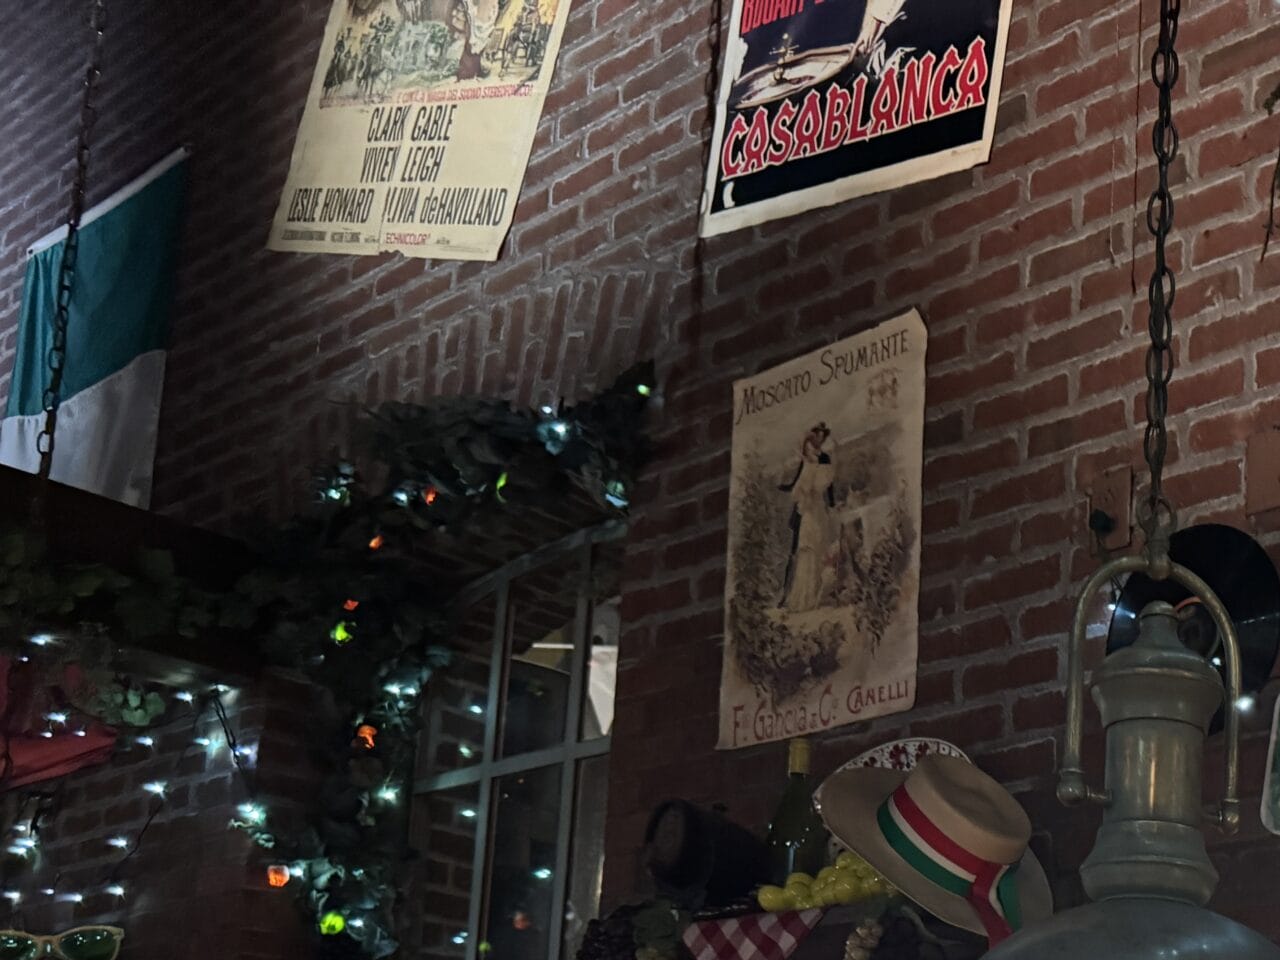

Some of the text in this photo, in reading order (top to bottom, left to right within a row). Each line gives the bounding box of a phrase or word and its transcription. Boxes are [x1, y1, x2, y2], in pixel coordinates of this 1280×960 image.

[367, 104, 457, 142] CLARK GABLE
[721, 34, 988, 182] CASABLANCA
[360, 145, 446, 183] VIVIEN LEIGH
[287, 188, 323, 222] LESLIE
[319, 188, 375, 224] HOWARD
